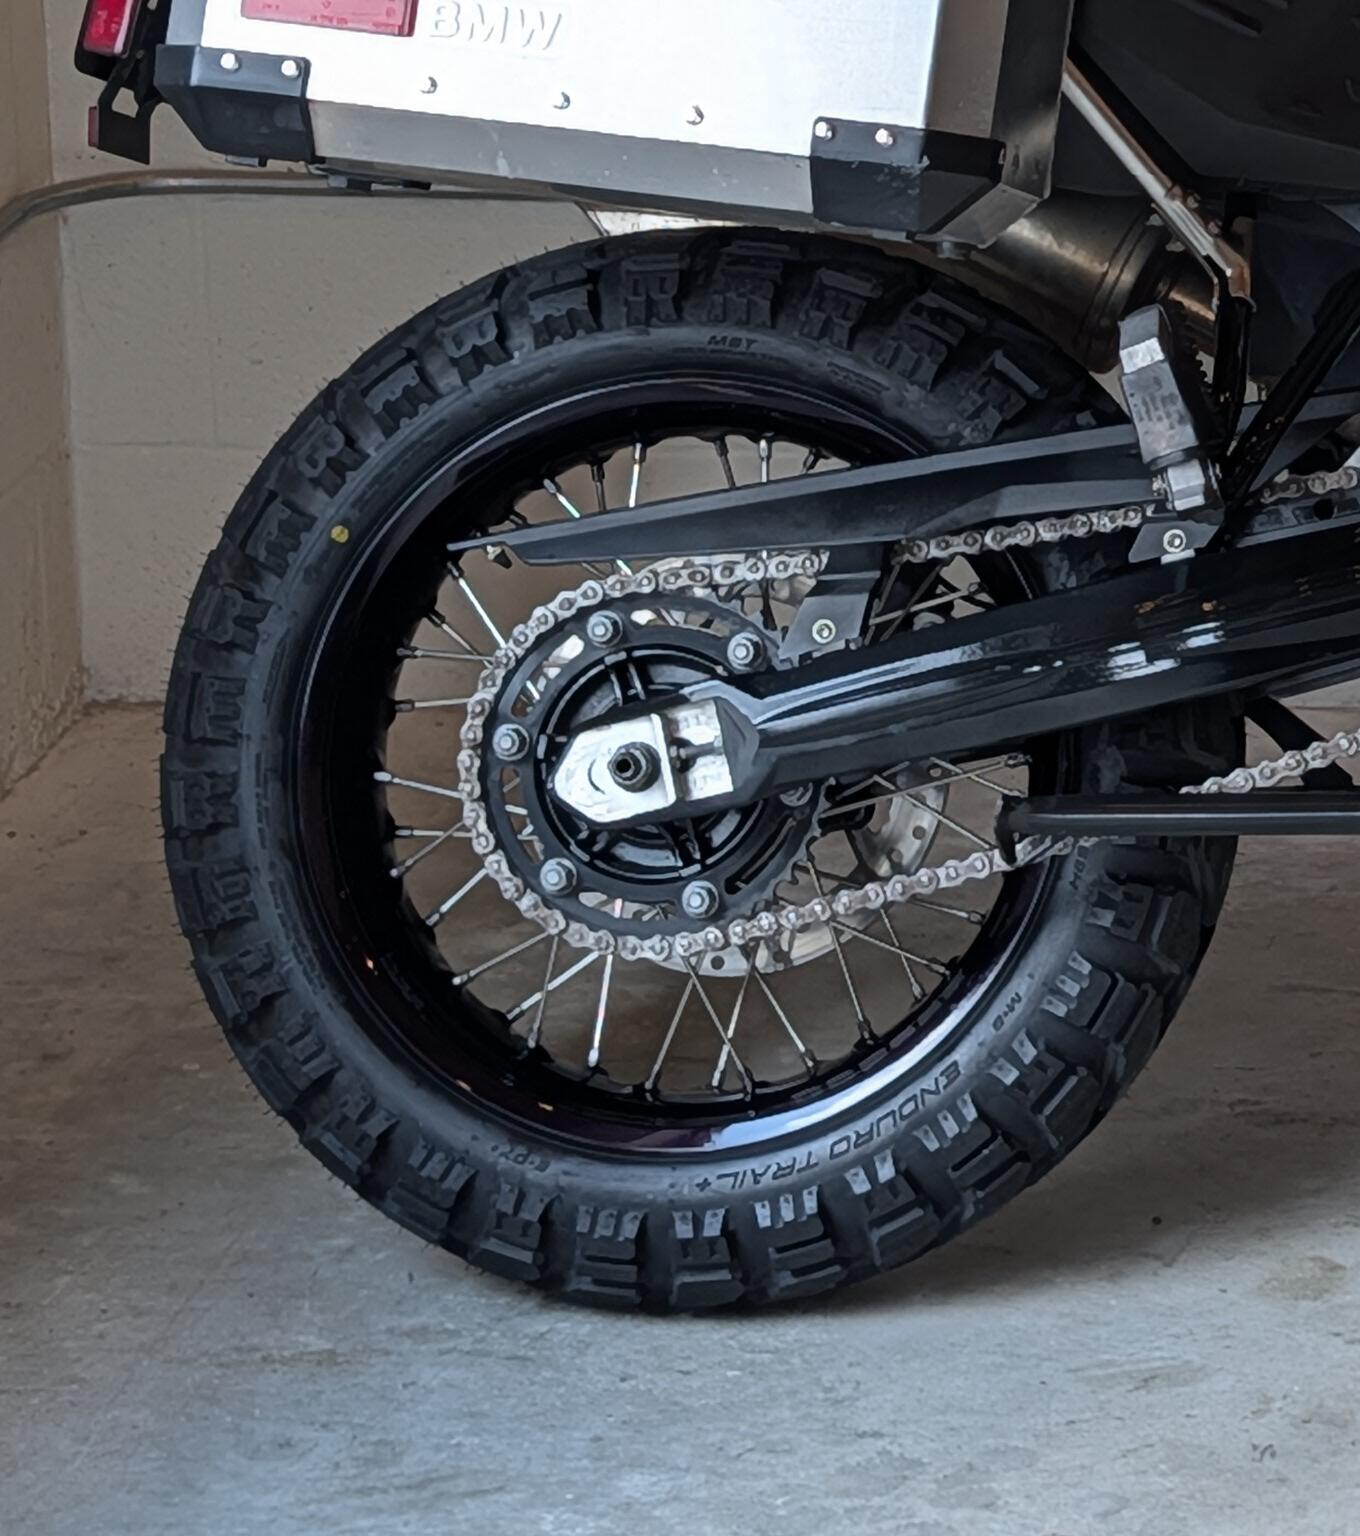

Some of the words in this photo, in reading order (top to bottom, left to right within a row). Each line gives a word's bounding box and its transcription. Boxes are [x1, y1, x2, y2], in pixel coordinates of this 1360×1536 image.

[429, 0, 563, 50] BMW
[828, 1059, 962, 1161] ENDURO
[695, 1150, 819, 1193] TRAIL+
